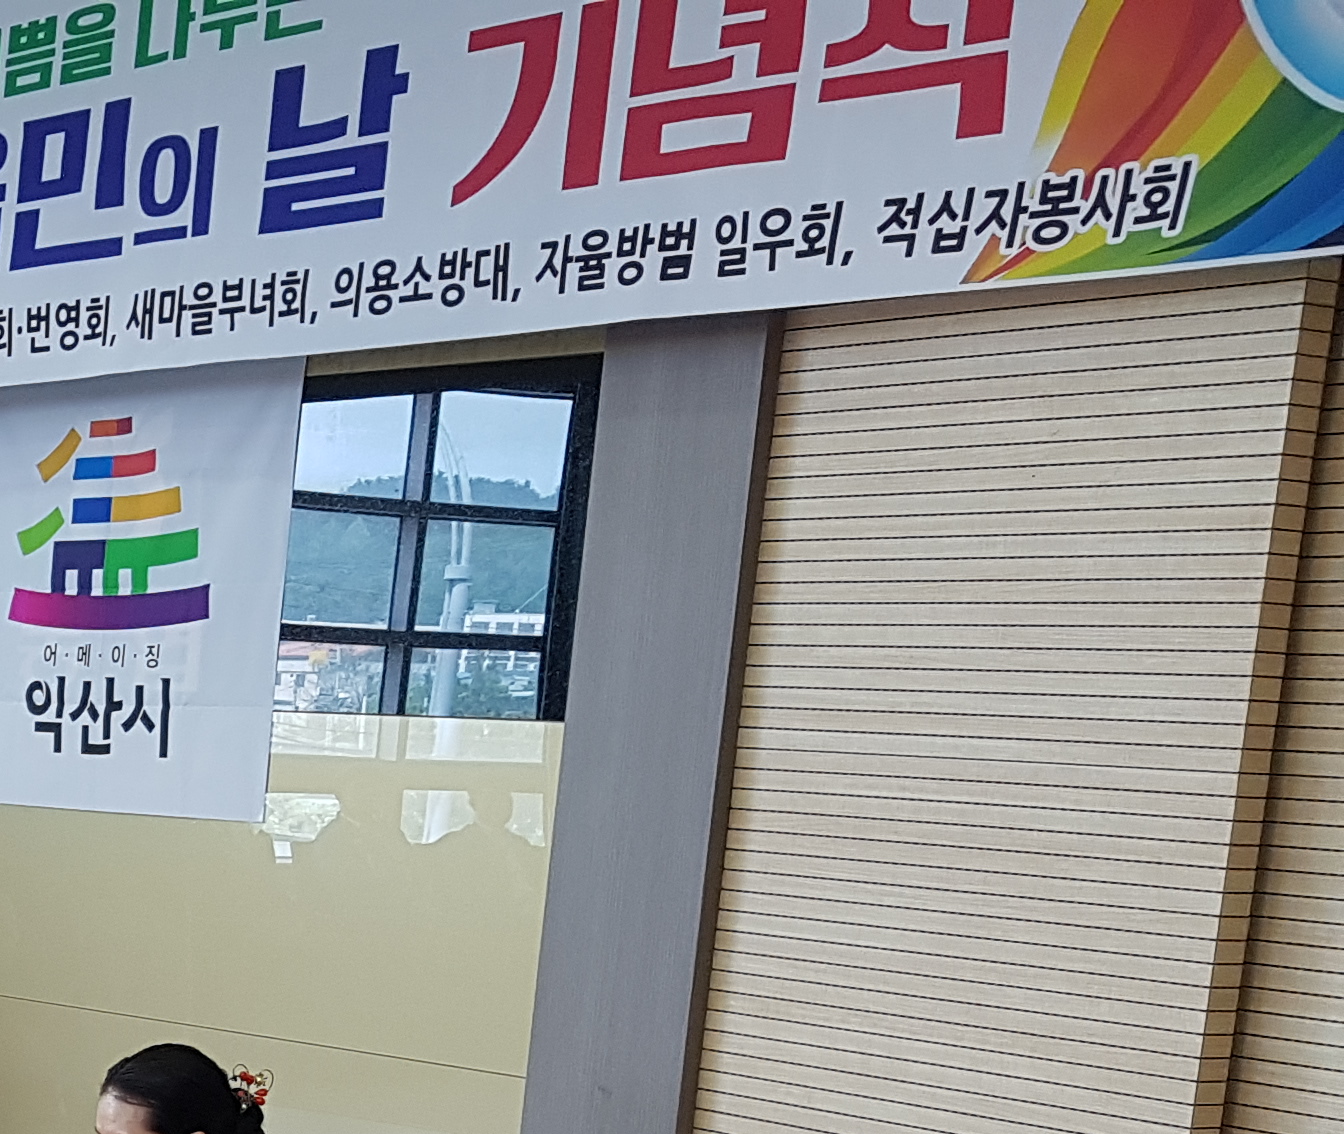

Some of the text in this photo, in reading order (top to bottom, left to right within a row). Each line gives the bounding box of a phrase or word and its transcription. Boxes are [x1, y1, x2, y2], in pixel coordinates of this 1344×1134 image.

[257, 43, 411, 236] 날
[449, 0, 1015, 207] 기념식
[125, 268, 319, 342] 새마을부녀회,
[329, 241, 522, 318] 의용소방대,
[535, 217, 698, 296] 자율방범
[714, 200, 854, 279] 일우회,
[876, 160, 1193, 258] 적십자봉사회
[25, 675, 171, 759] 익산시
